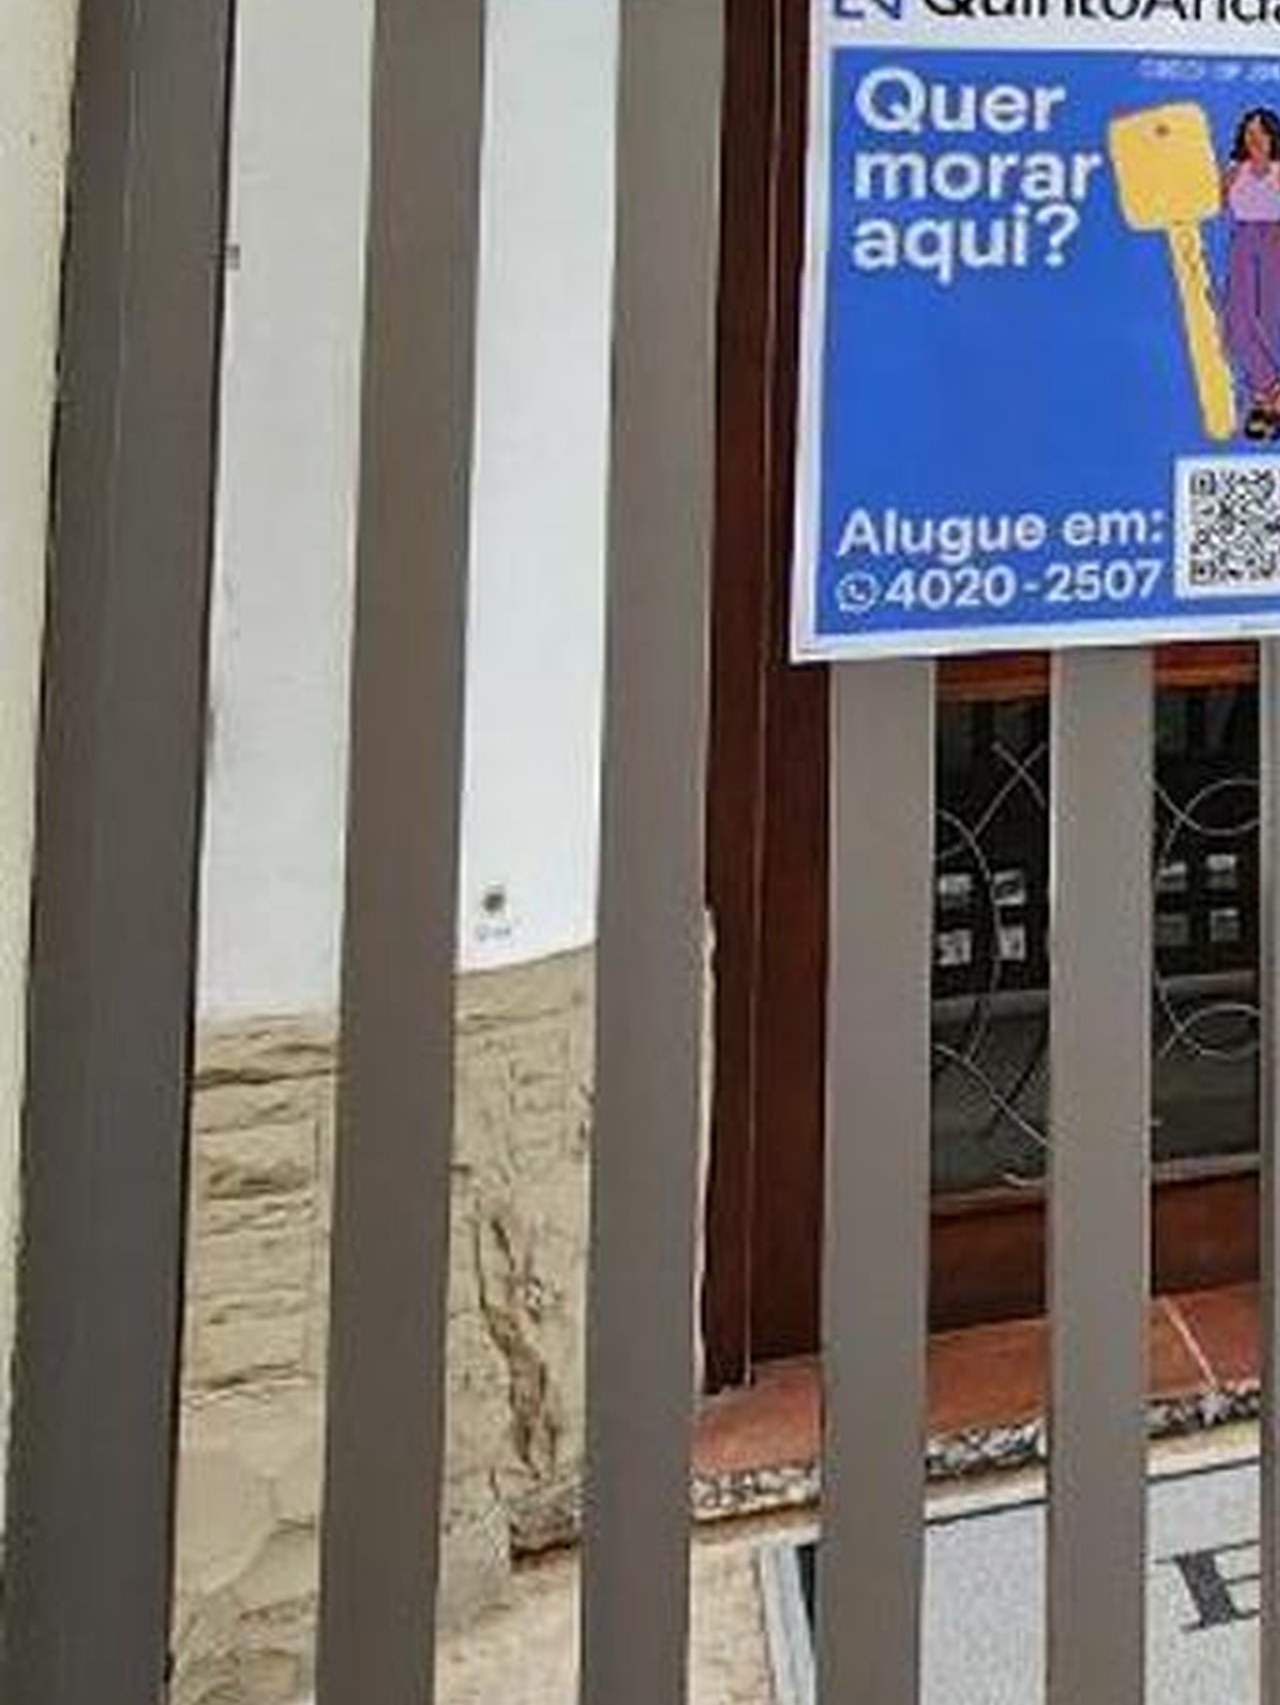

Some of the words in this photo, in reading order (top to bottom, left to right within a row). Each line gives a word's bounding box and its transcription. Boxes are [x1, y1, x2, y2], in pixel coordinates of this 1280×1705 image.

[854, 67, 1066, 133] Quer
[852, 147, 1102, 202] morar
[851, 204, 1080, 285] aqui?
[837, 507, 1047, 566] Alugue
[1061, 508, 1166, 547] em:
